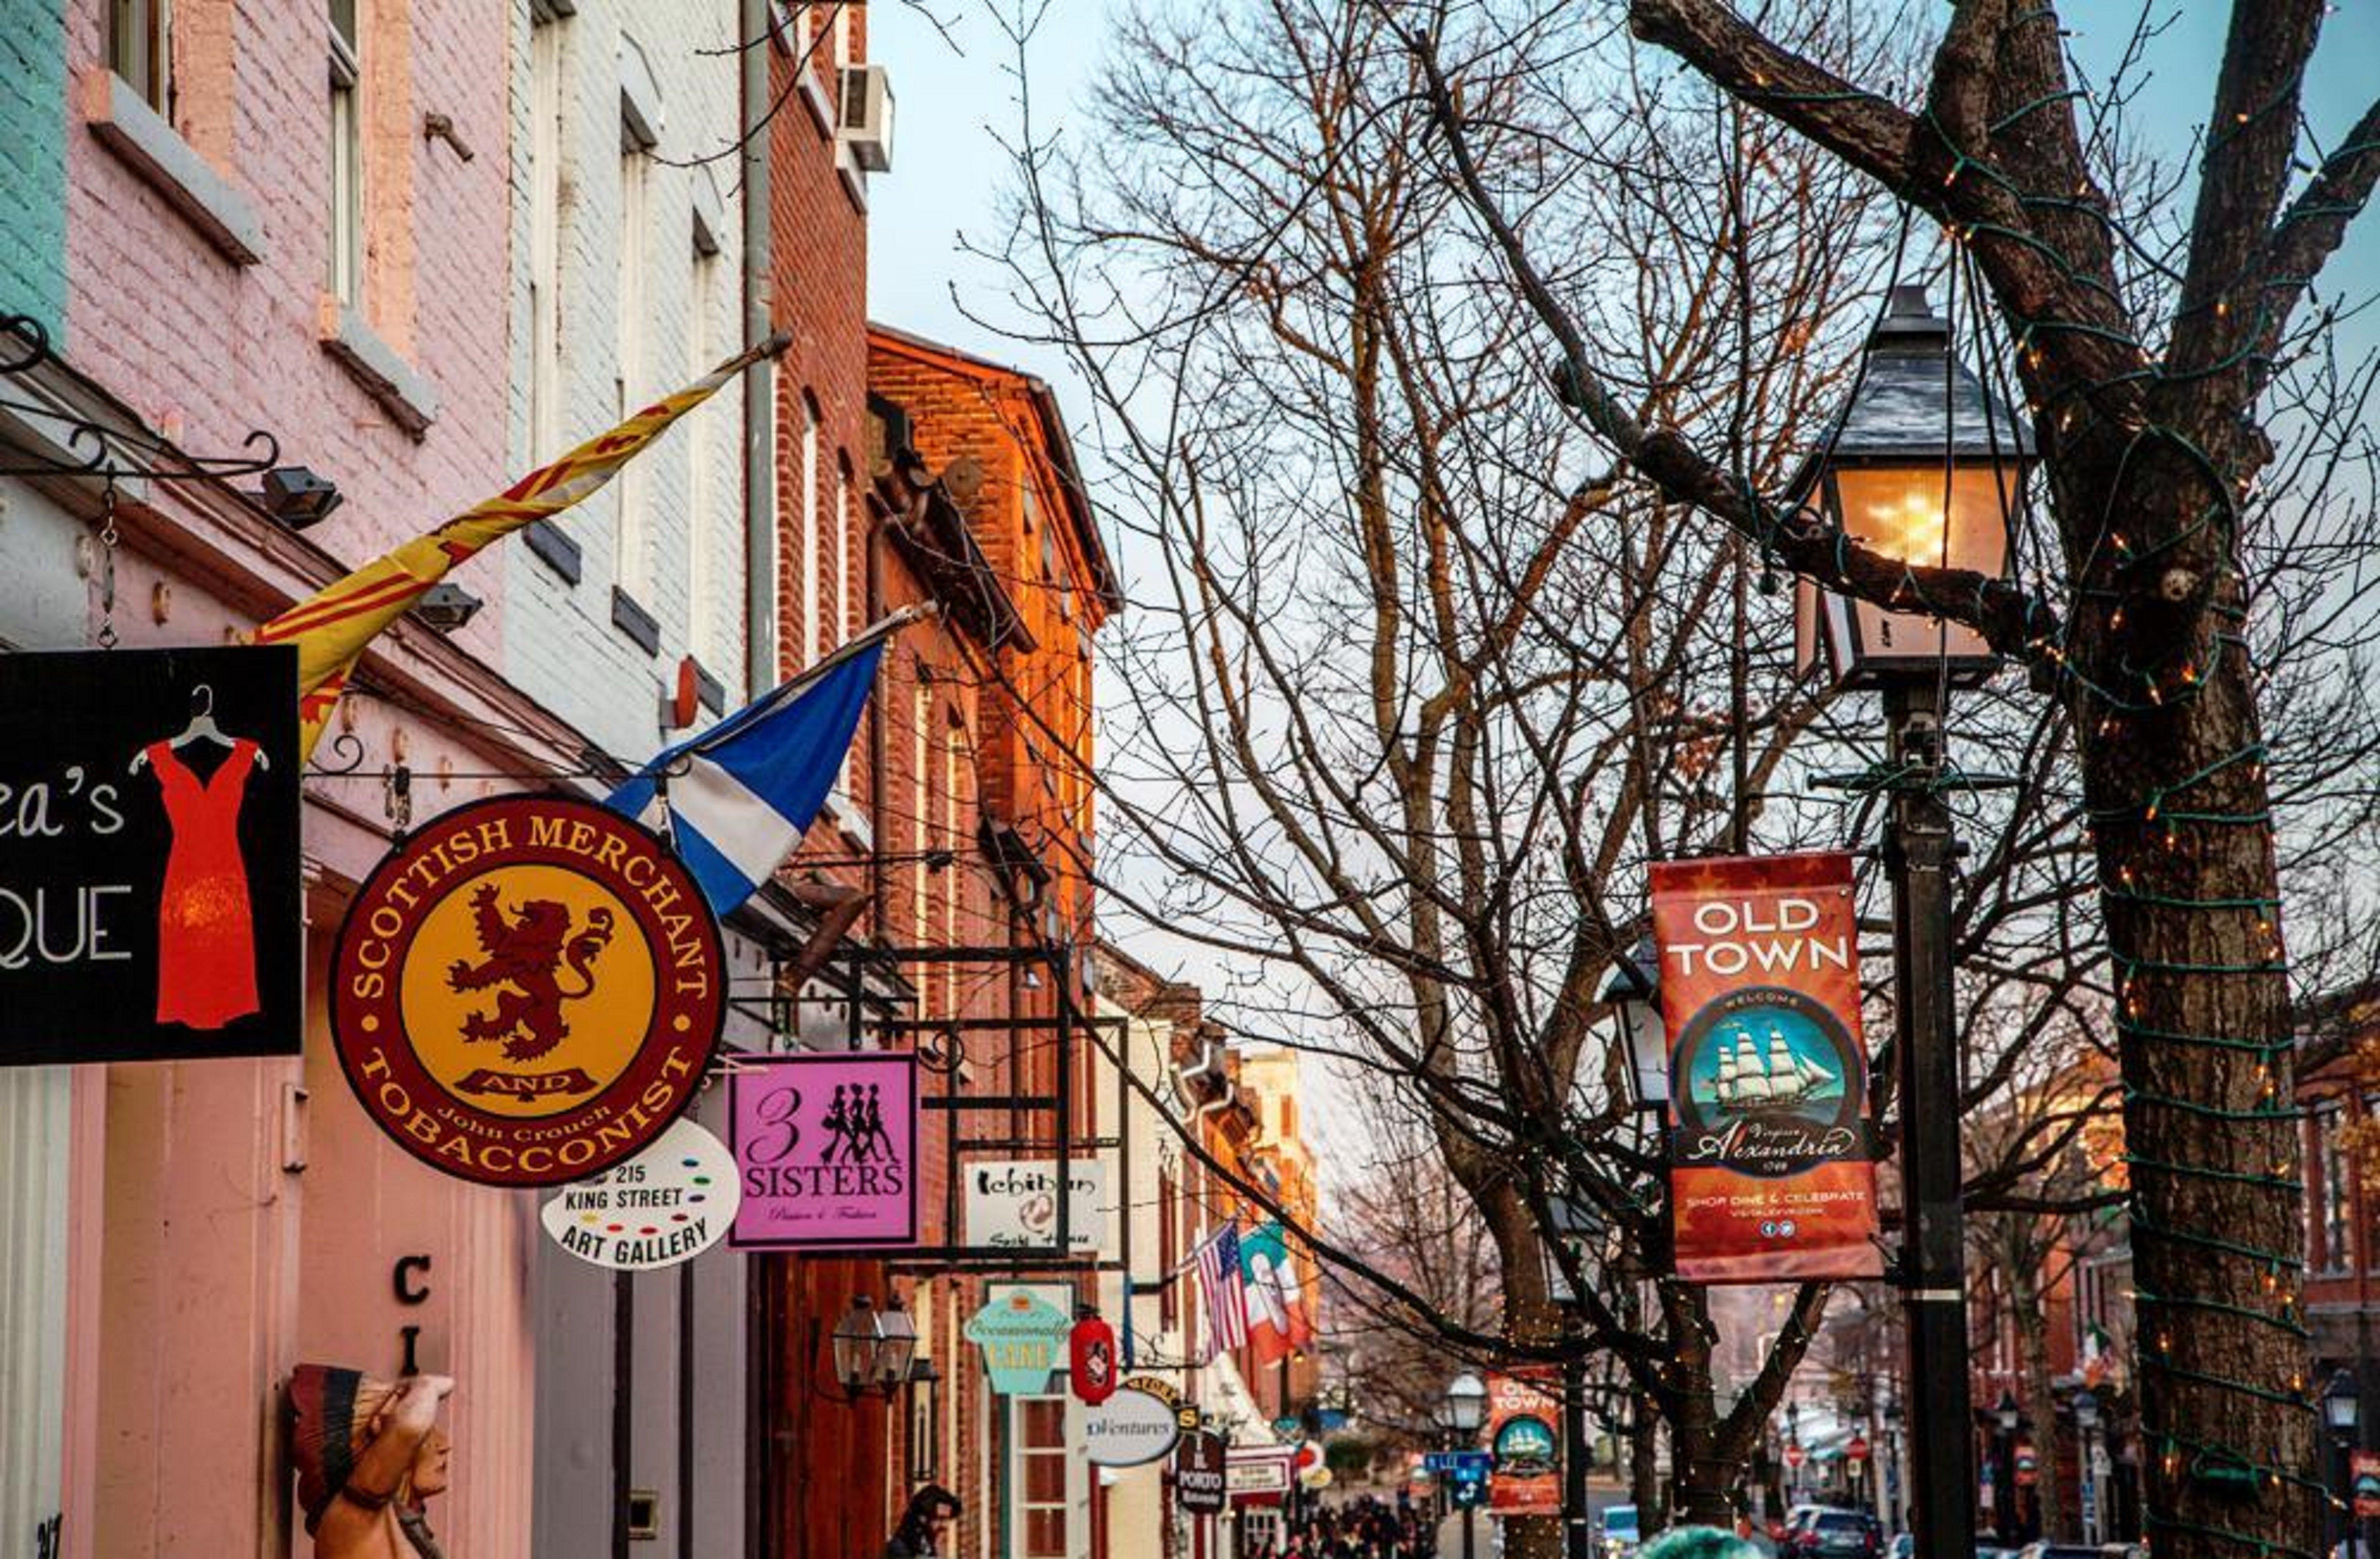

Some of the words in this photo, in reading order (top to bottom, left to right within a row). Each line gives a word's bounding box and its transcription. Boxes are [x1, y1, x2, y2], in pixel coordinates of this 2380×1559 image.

[353, 817, 512, 999] SCOTTISH
[529, 815, 708, 1000] MERCHANT
[1694, 899, 1819, 935] OLD
[1666, 937, 1849, 977] TOWN
[1723, 990, 1798, 1009] WELCOME
[481, 1075, 572, 1091] AND
[361, 1046, 692, 1172] TOBACCONIST
[437, 1105, 503, 1141] John
[514, 1105, 611, 1142] Crouch
[745, 1087, 801, 1164] 3
[1687, 1120, 1855, 1160] Alexandria
[616, 1165, 646, 1184] 215
[745, 1165, 904, 1198] SISTERS
[565, 1192, 608, 1210] KING
[616, 1188, 683, 1208] STREET
[1686, 1197, 1727, 1208] SHOP
[1730, 1195, 1764, 1206] DINE
[1784, 1191, 1866, 1202] CELEBRATE
[561, 1225, 606, 1260] ART
[614, 1217, 709, 1264] GALLERY
[1492, 1396, 1556, 1410] TOWN
